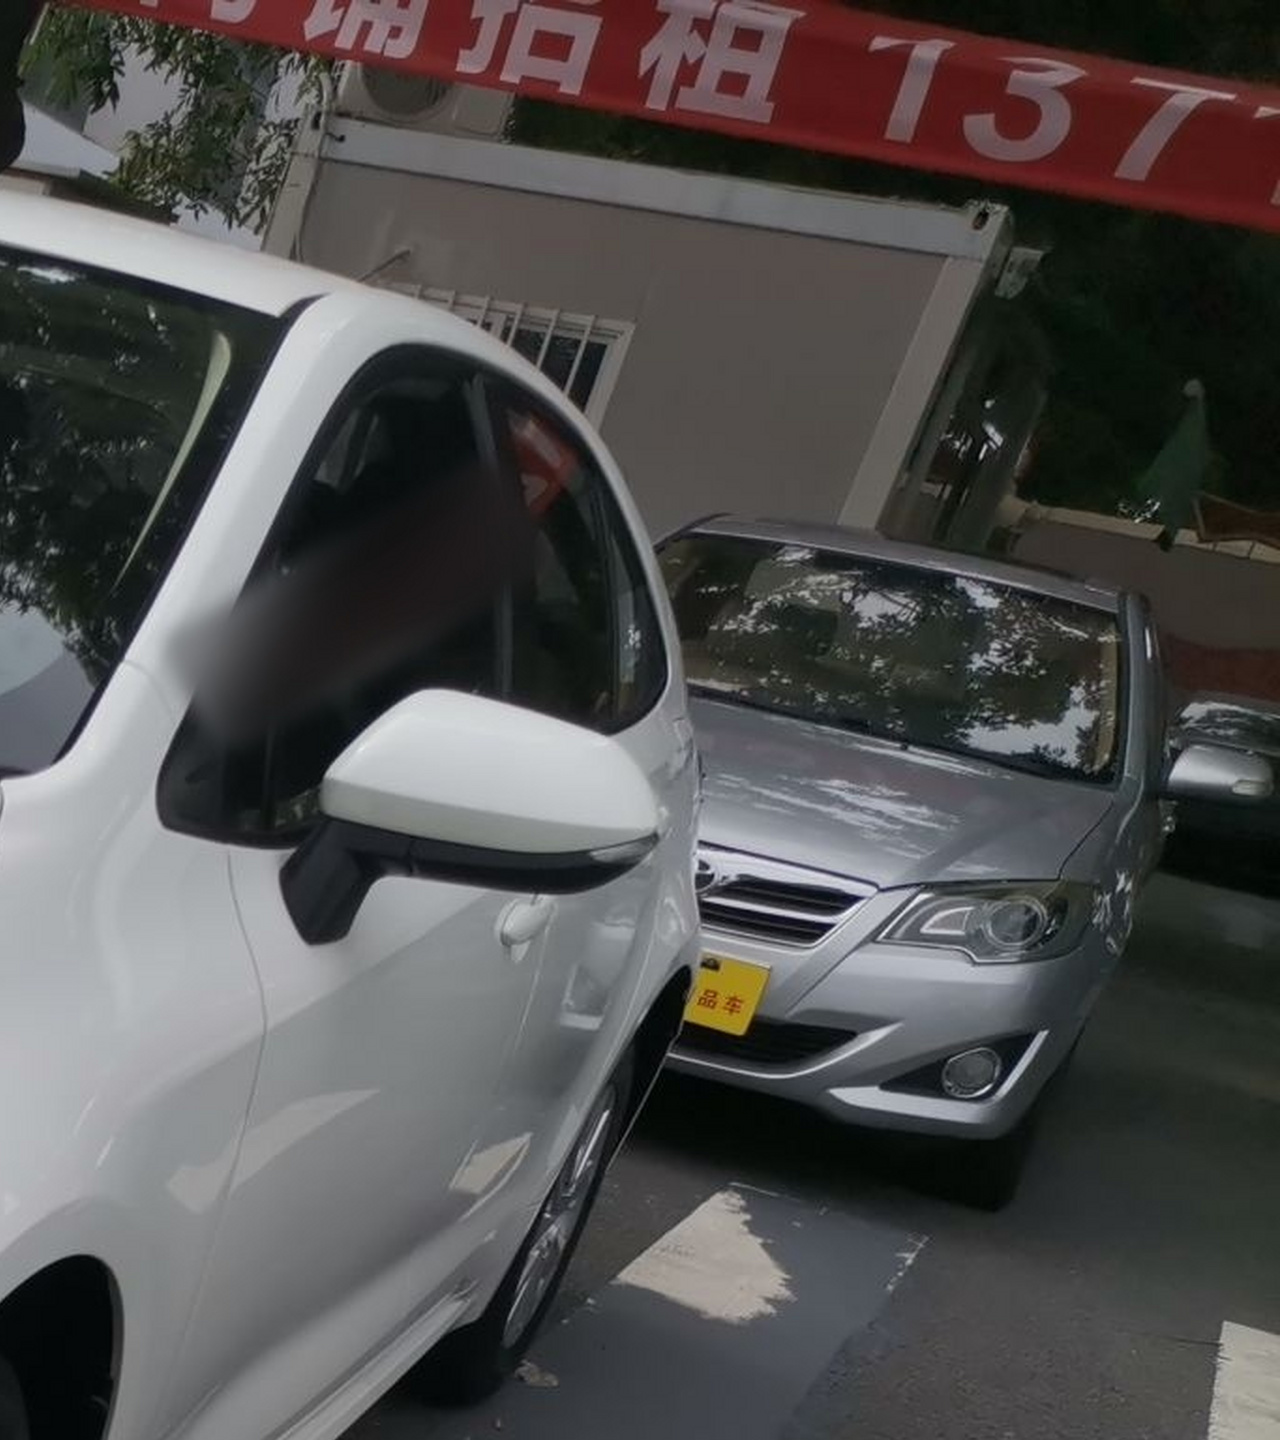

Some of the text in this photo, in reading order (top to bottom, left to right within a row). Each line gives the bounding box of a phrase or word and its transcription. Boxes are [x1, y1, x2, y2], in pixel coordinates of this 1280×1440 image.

[141, 0, 1280, 206] 铺招租 137
[697, 989, 744, 1015] 品车
